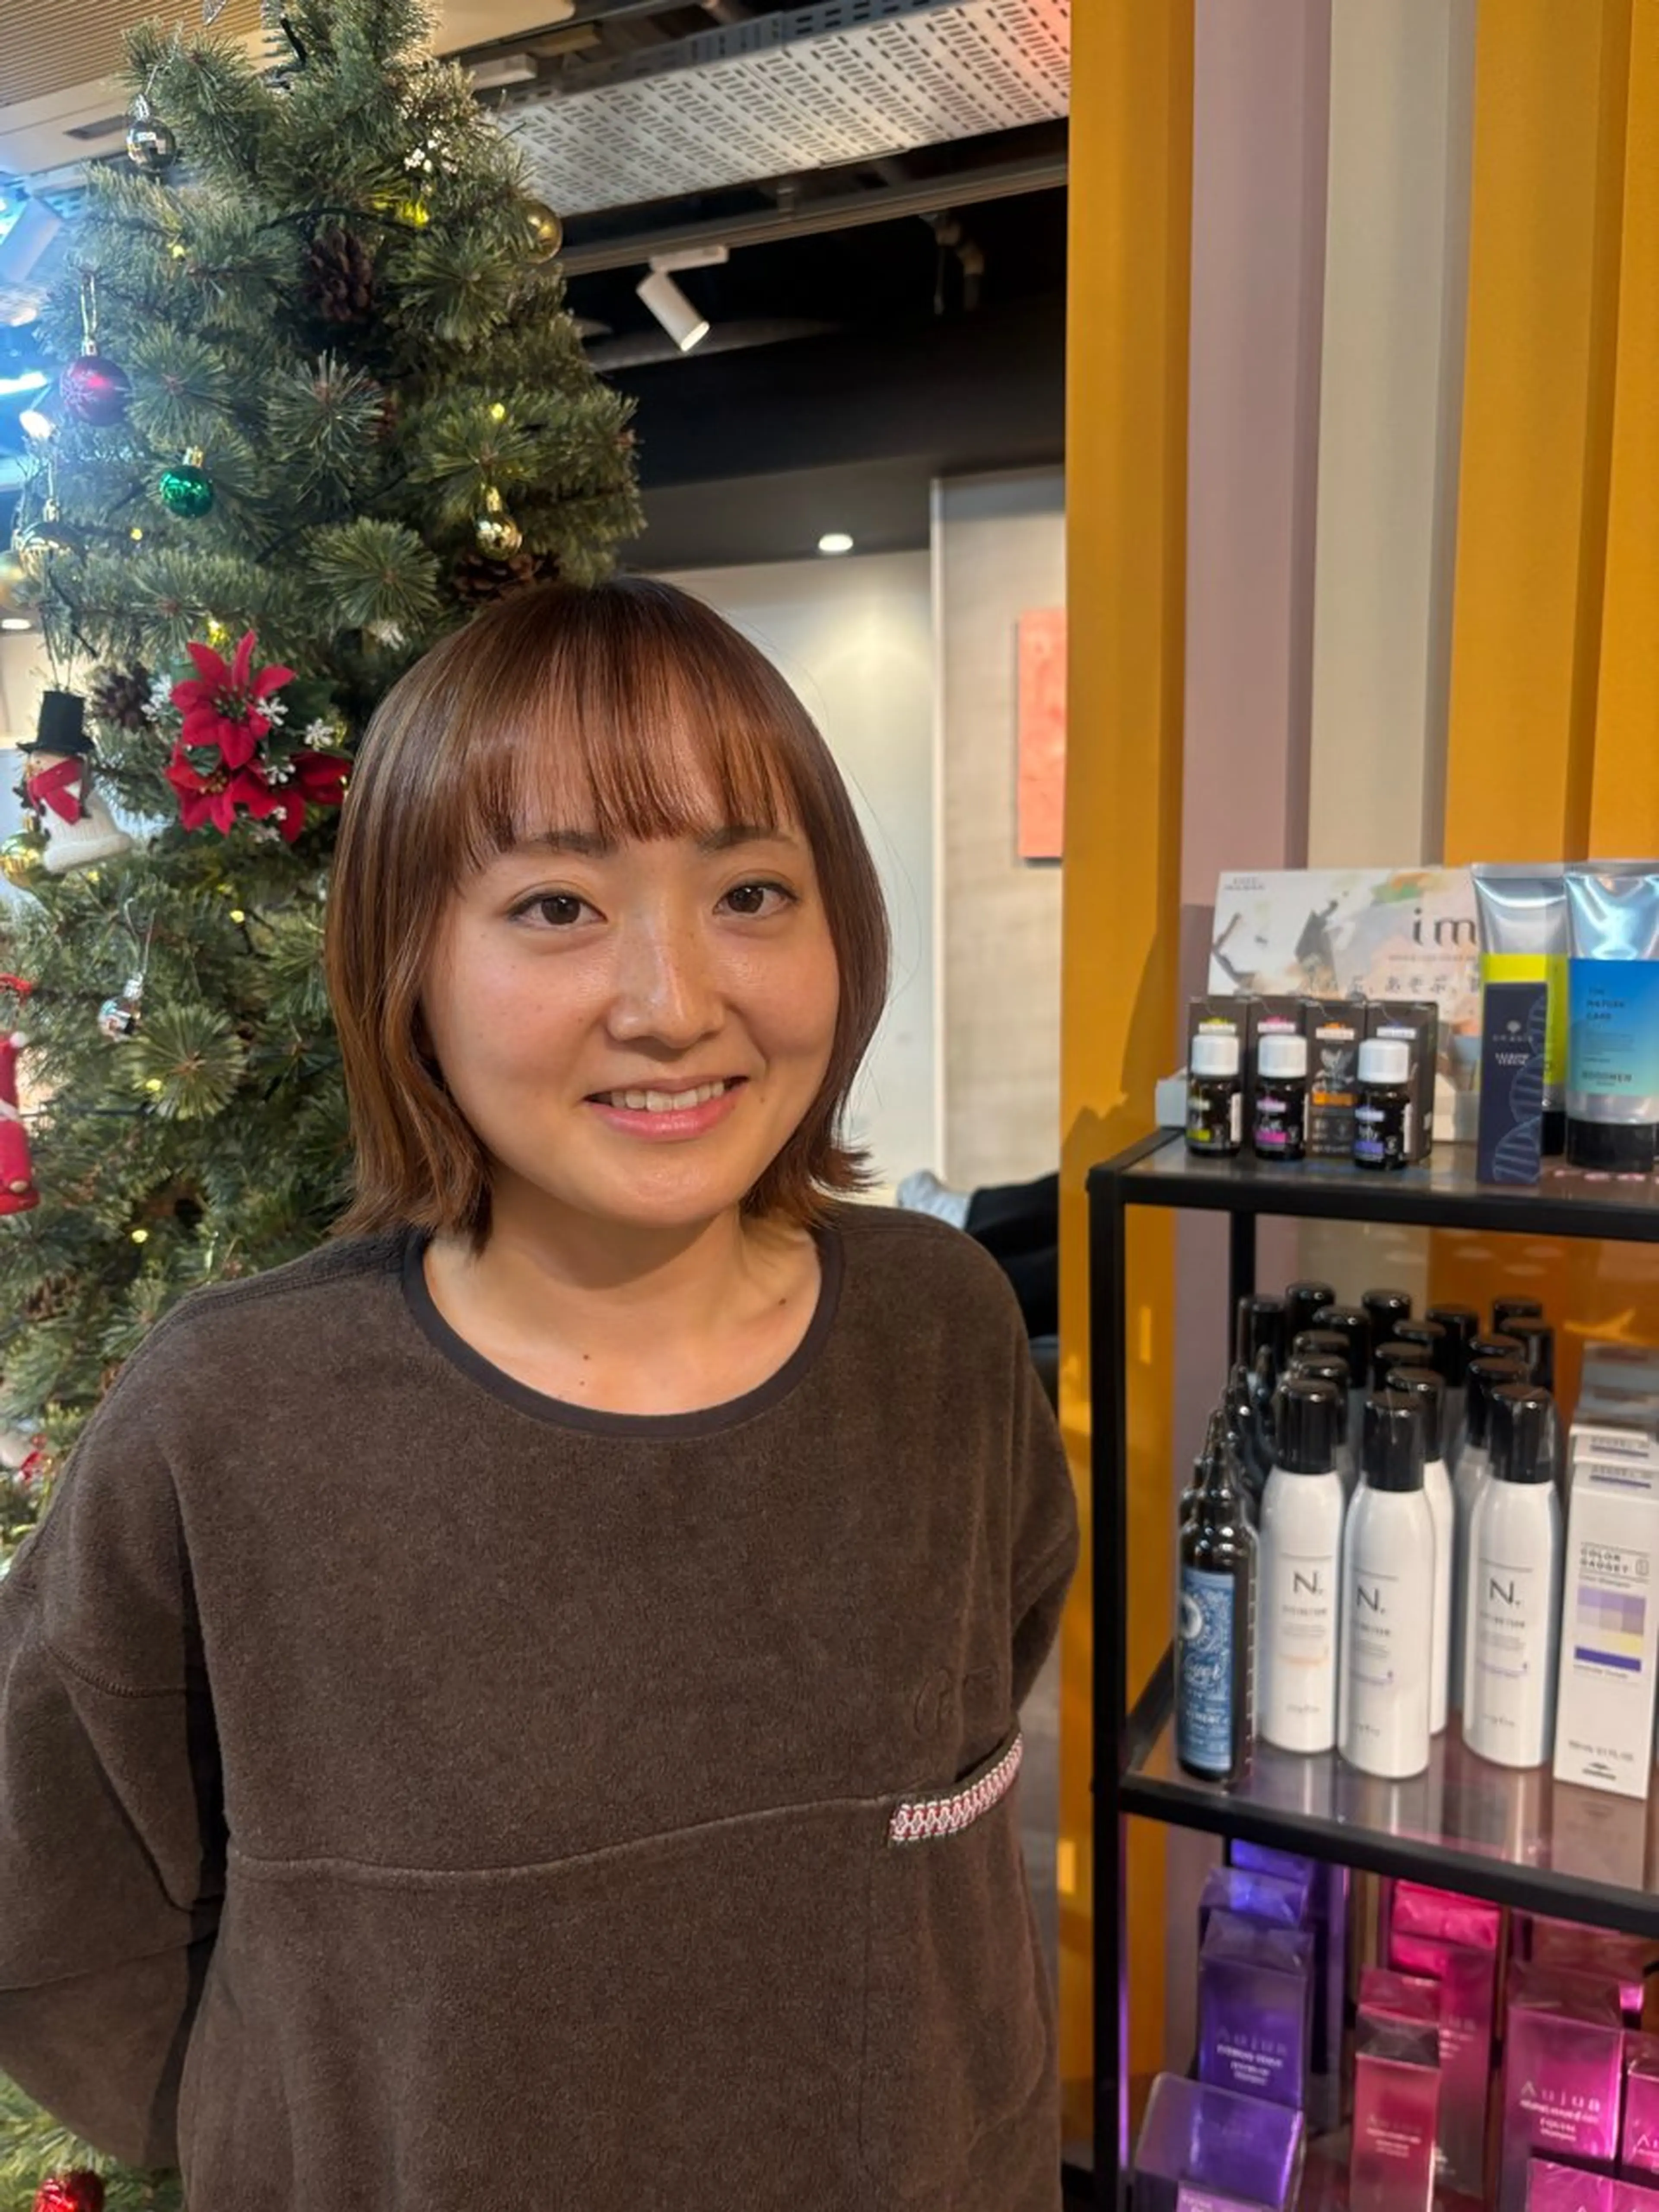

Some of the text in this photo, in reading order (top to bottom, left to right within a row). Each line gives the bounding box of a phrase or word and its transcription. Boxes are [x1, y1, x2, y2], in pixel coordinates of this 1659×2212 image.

[1293, 1570, 1324, 1595] N.
[1490, 1577, 1521, 1608] N.
[1356, 1585, 1386, 1615] N.
